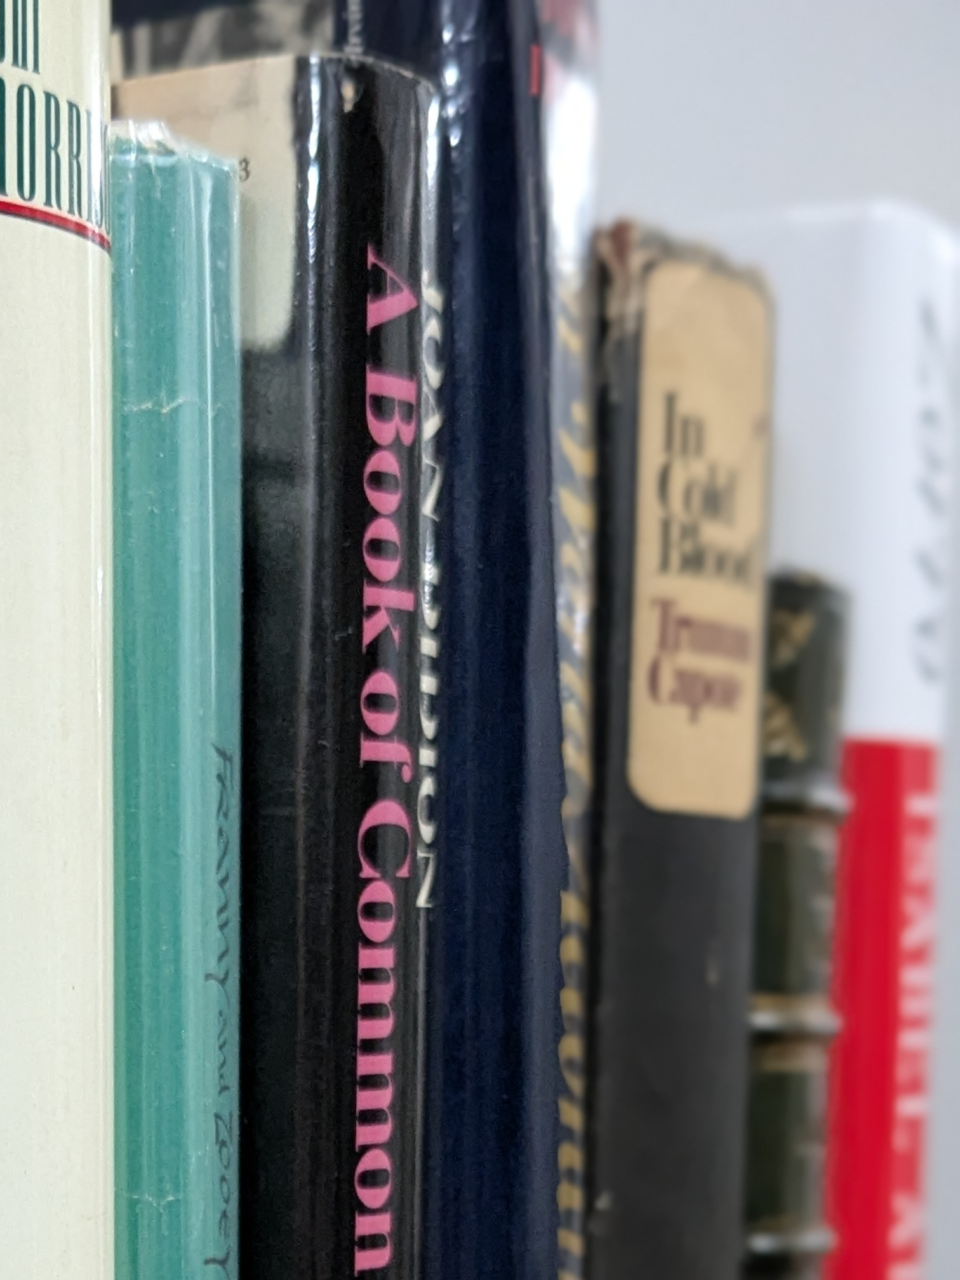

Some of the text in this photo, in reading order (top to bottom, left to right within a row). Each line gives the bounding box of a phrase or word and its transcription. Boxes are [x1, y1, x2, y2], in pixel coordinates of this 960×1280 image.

[366, 244, 419, 335] A
[362, 362, 418, 655] Book
[359, 671, 413, 783] of
[352, 799, 412, 1277] Common
